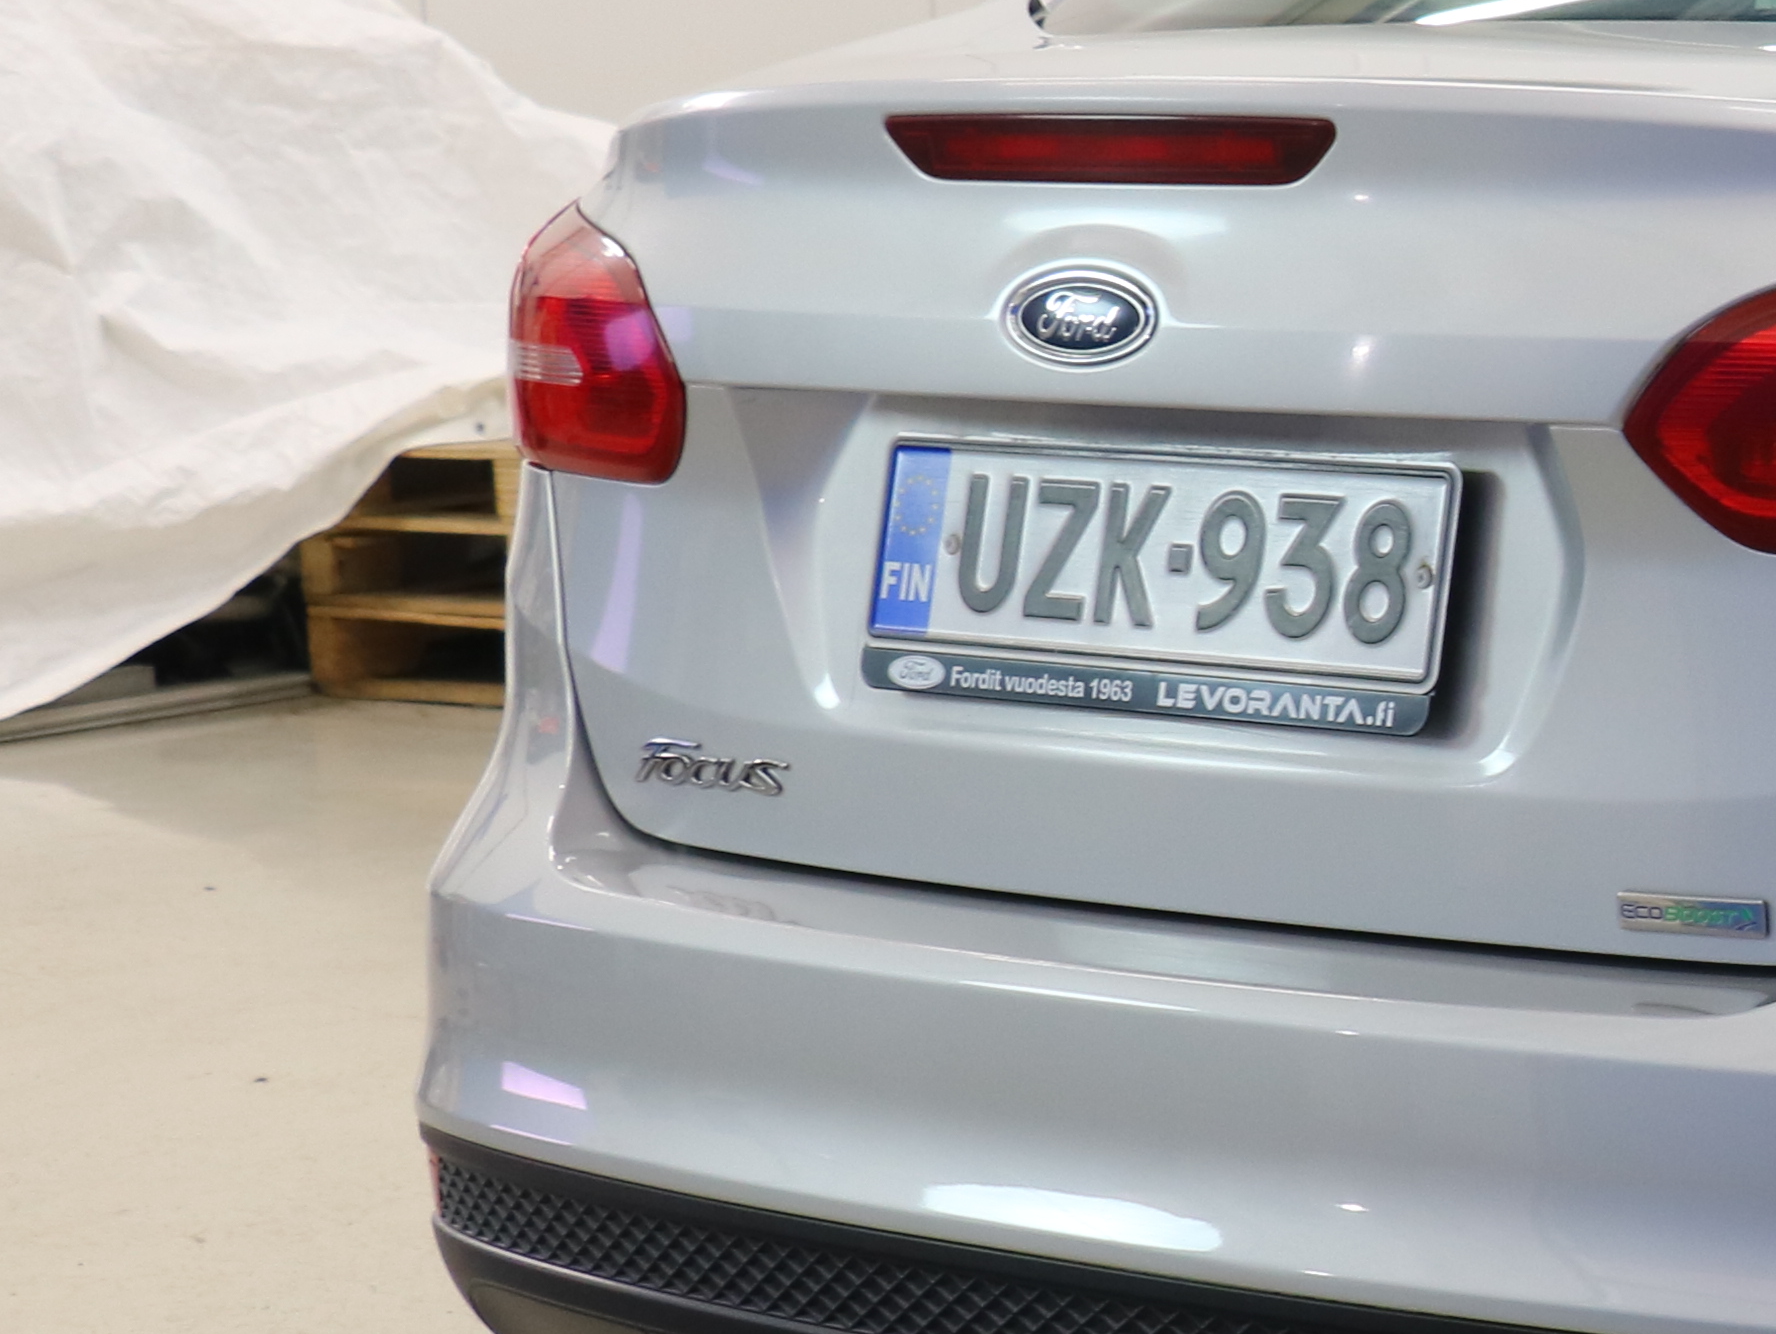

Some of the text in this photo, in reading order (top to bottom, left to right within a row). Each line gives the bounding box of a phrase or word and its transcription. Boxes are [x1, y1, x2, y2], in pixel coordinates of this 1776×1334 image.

[1036, 291, 1121, 343] Ford
[957, 472, 1412, 645] UZK-938
[880, 561, 931, 604] FIN
[950, 666, 1133, 702] Fordit vuodesta 1963
[1156, 681, 1396, 728] LEVORANTA.fi
